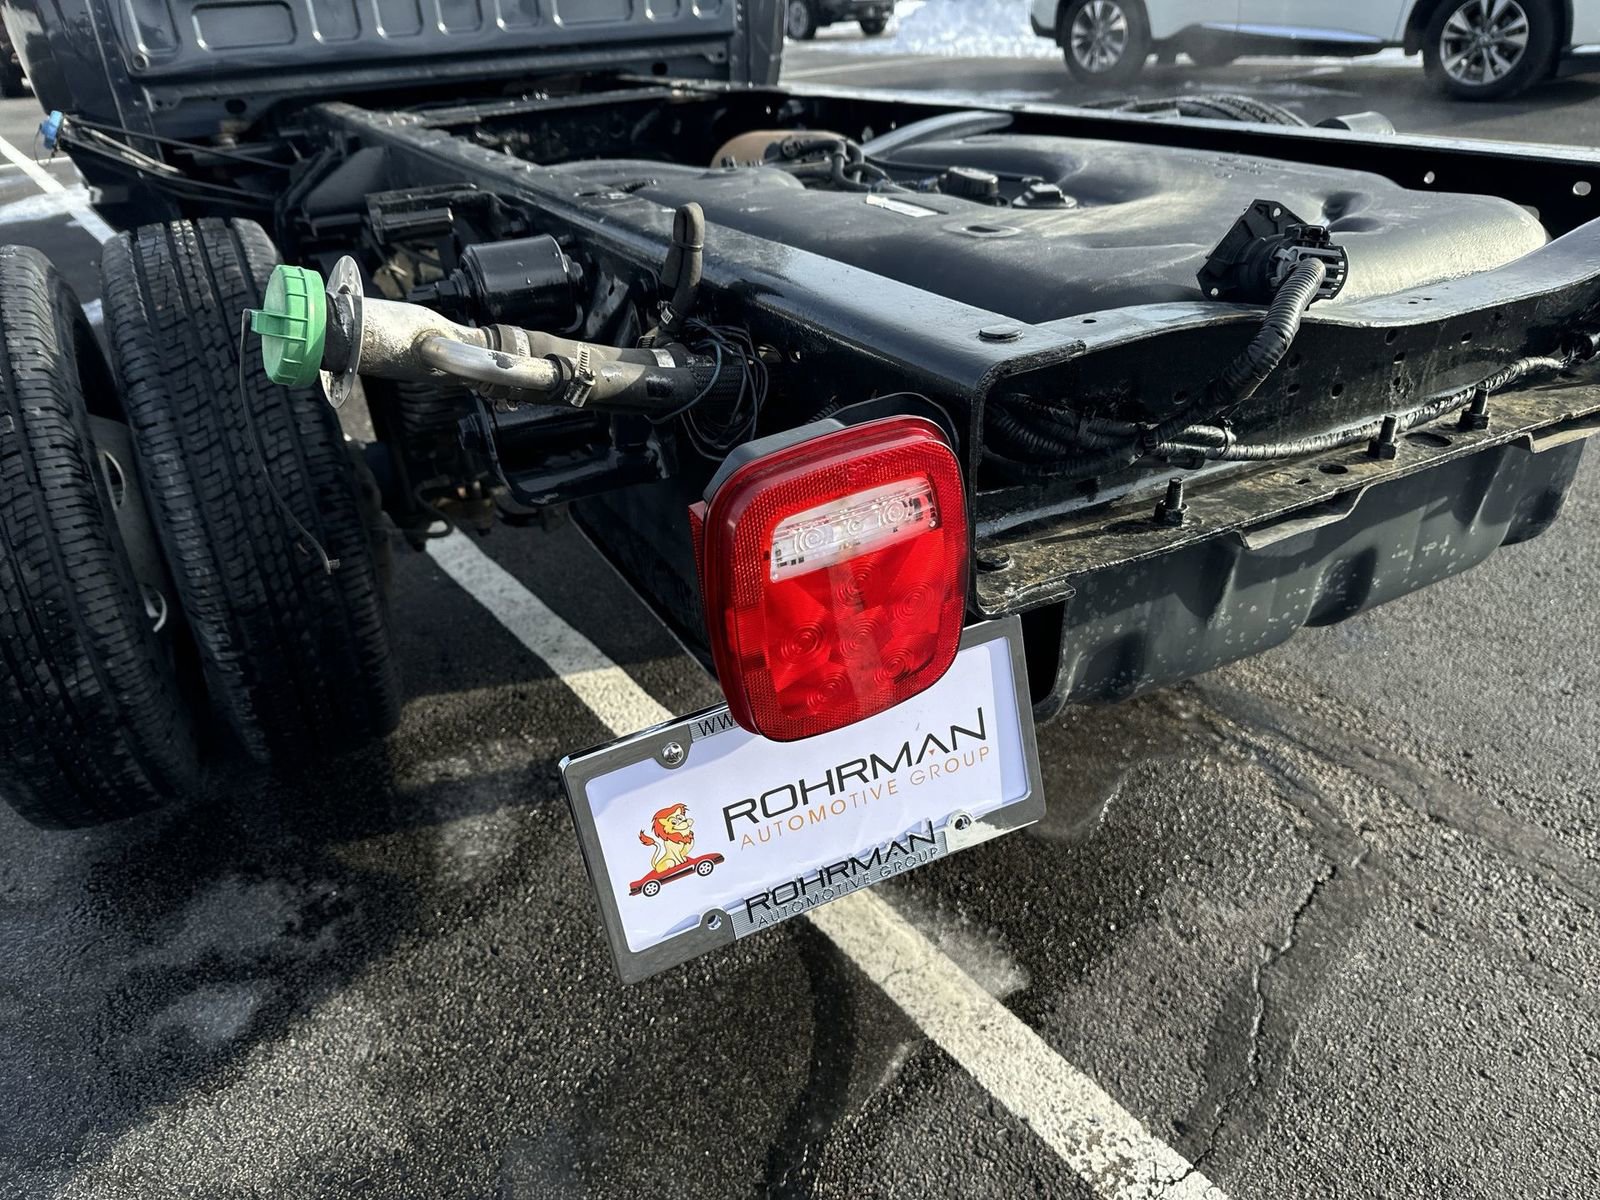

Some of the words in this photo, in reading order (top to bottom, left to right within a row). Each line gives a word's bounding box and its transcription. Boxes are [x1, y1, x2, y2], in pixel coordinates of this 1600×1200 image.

[722, 707, 986, 841] ROHRMAN
[740, 778, 899, 850] AUTOMOTIVE
[910, 746, 990, 785] GROUP
[745, 820, 936, 923] ROHRMAN
[757, 872, 872, 928] AUTOMOTIVE
[879, 847, 939, 878] GROUP
